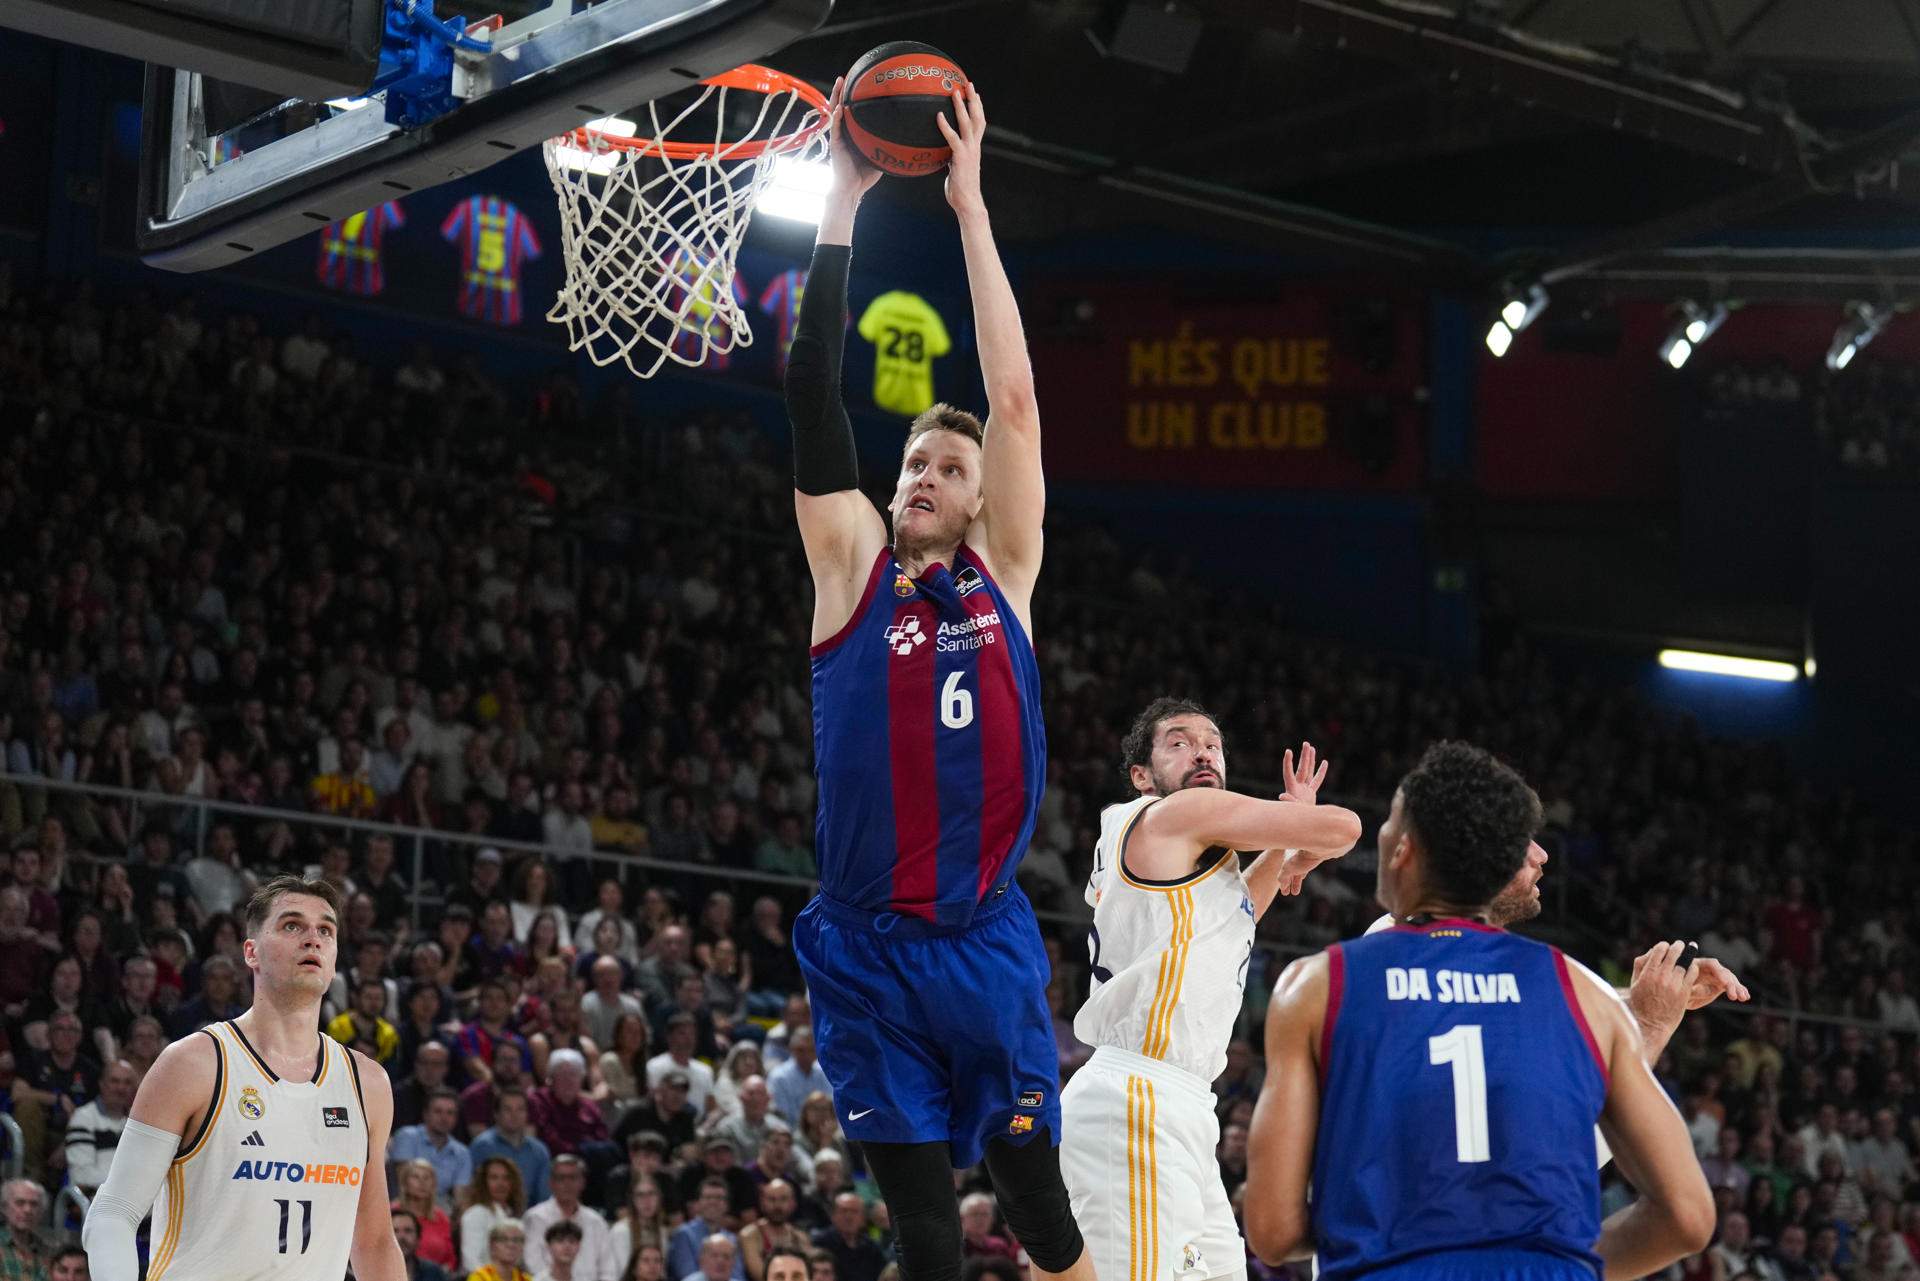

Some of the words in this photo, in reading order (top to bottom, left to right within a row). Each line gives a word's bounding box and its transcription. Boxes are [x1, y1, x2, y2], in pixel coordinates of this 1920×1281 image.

[874, 65, 942, 85] endesa
[477, 230, 505, 272] 5
[884, 326, 924, 364] 28
[1128, 319, 1219, 386] MÉS
[1232, 338, 1329, 399] QUE
[1128, 401, 1195, 447] UN
[1209, 401, 1326, 448] CLUB
[936, 630, 995, 653] Sanitària
[940, 671, 974, 729] 6
[1386, 967, 1432, 1001] DA
[1436, 969, 1521, 1003] SILVA
[1020, 1097, 1037, 1105] acb
[1428, 1025, 1491, 1162] 1
[232, 1160, 361, 1187] AUTOHERO
[273, 1199, 312, 1255] 11
